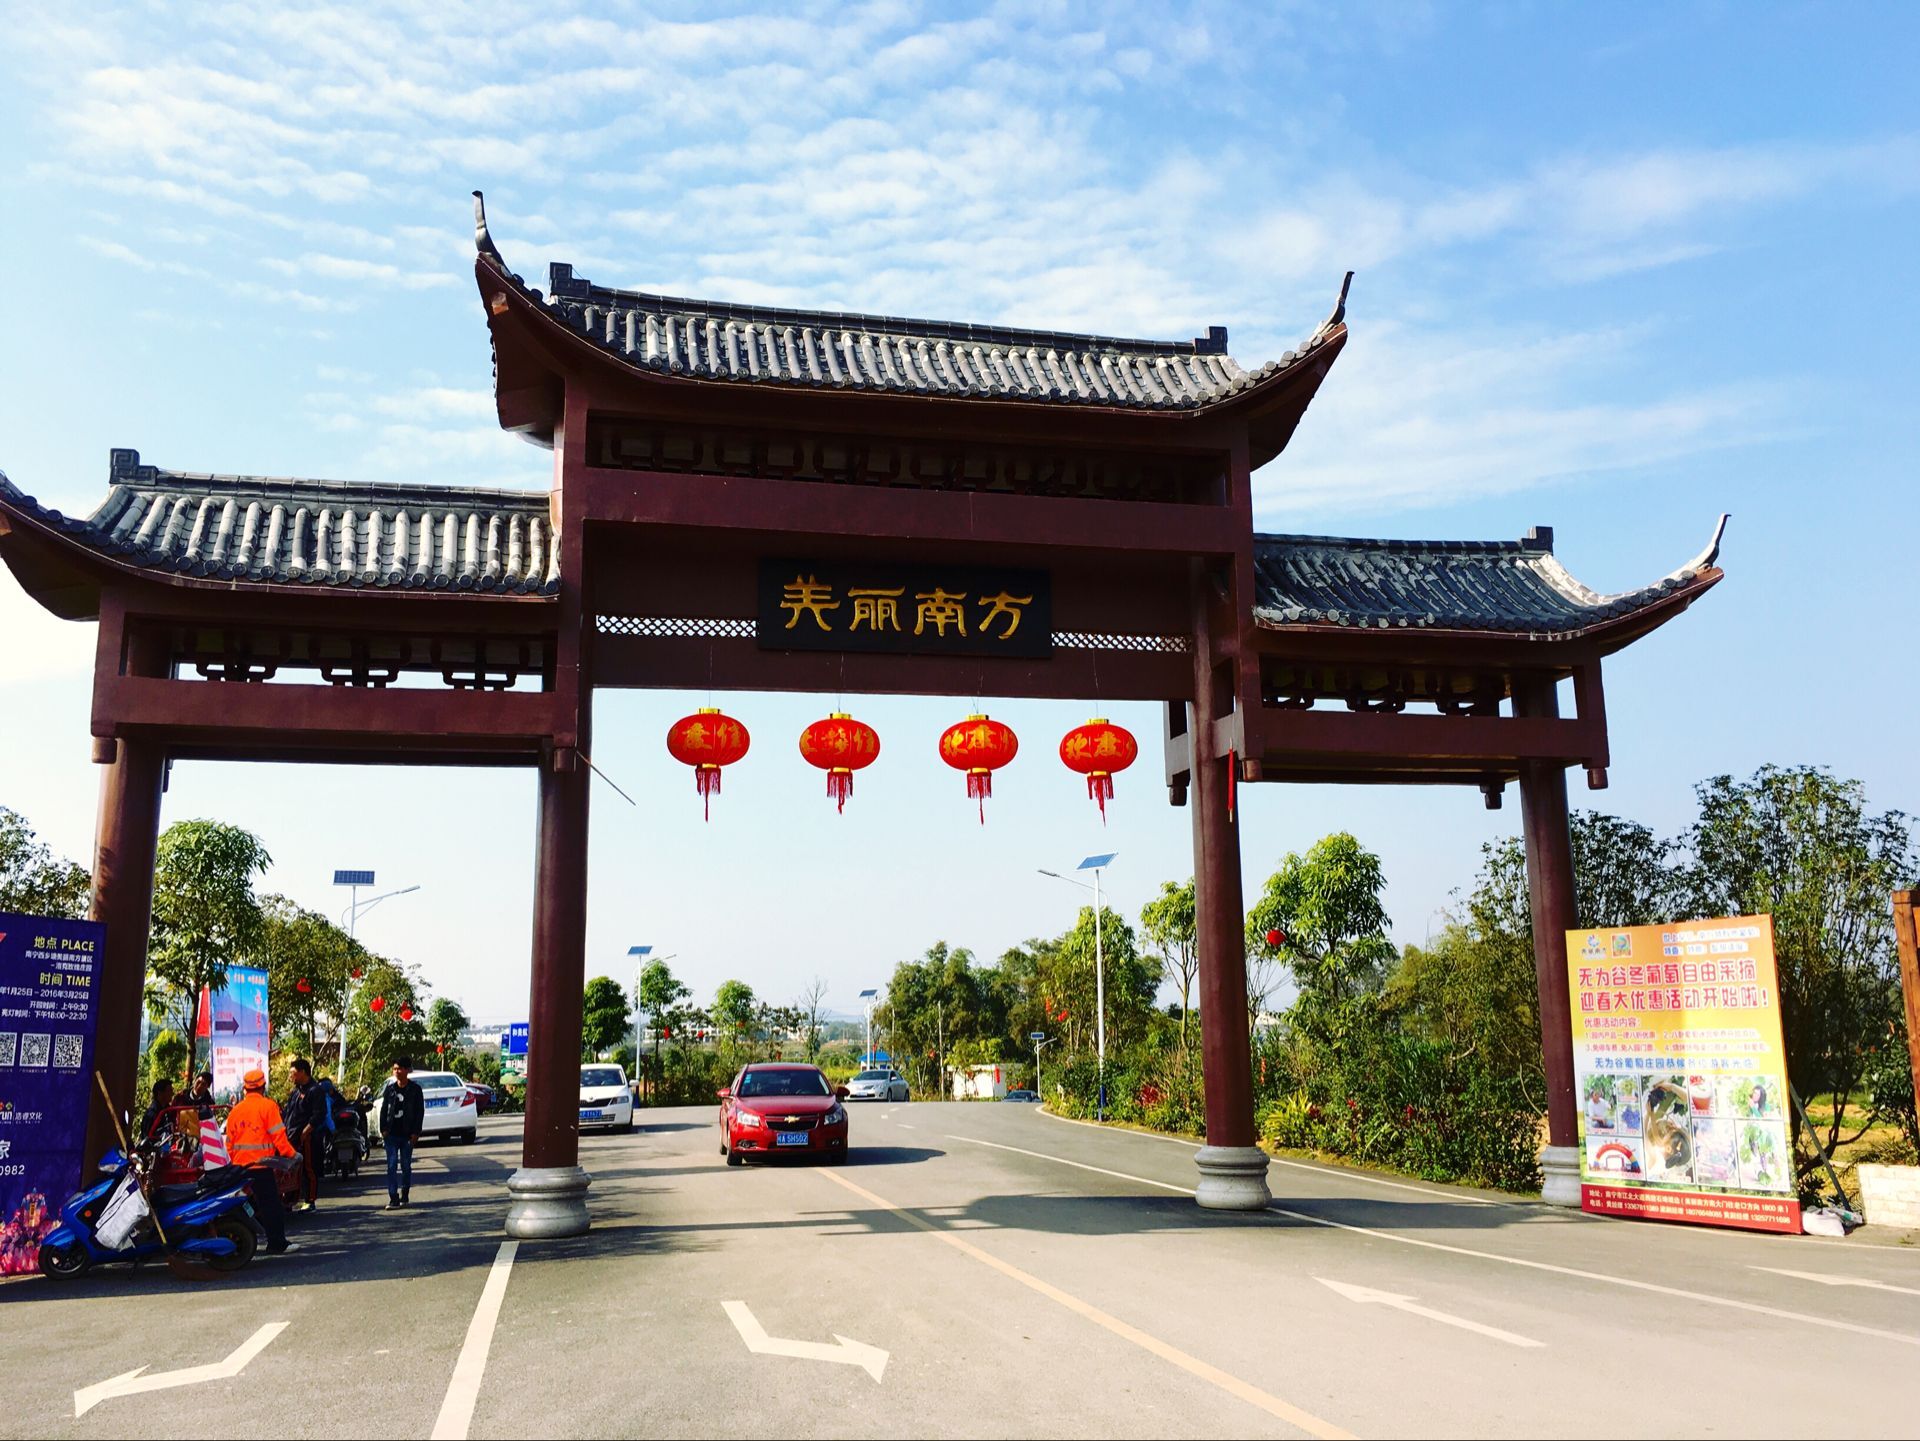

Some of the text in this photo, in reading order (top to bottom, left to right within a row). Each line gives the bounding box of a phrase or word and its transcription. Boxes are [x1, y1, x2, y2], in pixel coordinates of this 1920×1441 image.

[780, 573, 1033, 640] 美丽南方
[34, 936, 94, 952] 地点 PLACE
[40, 972, 91, 987] 时间 TIME
[1579, 960, 1755, 987] 无为谷冬葡萄自由采摘
